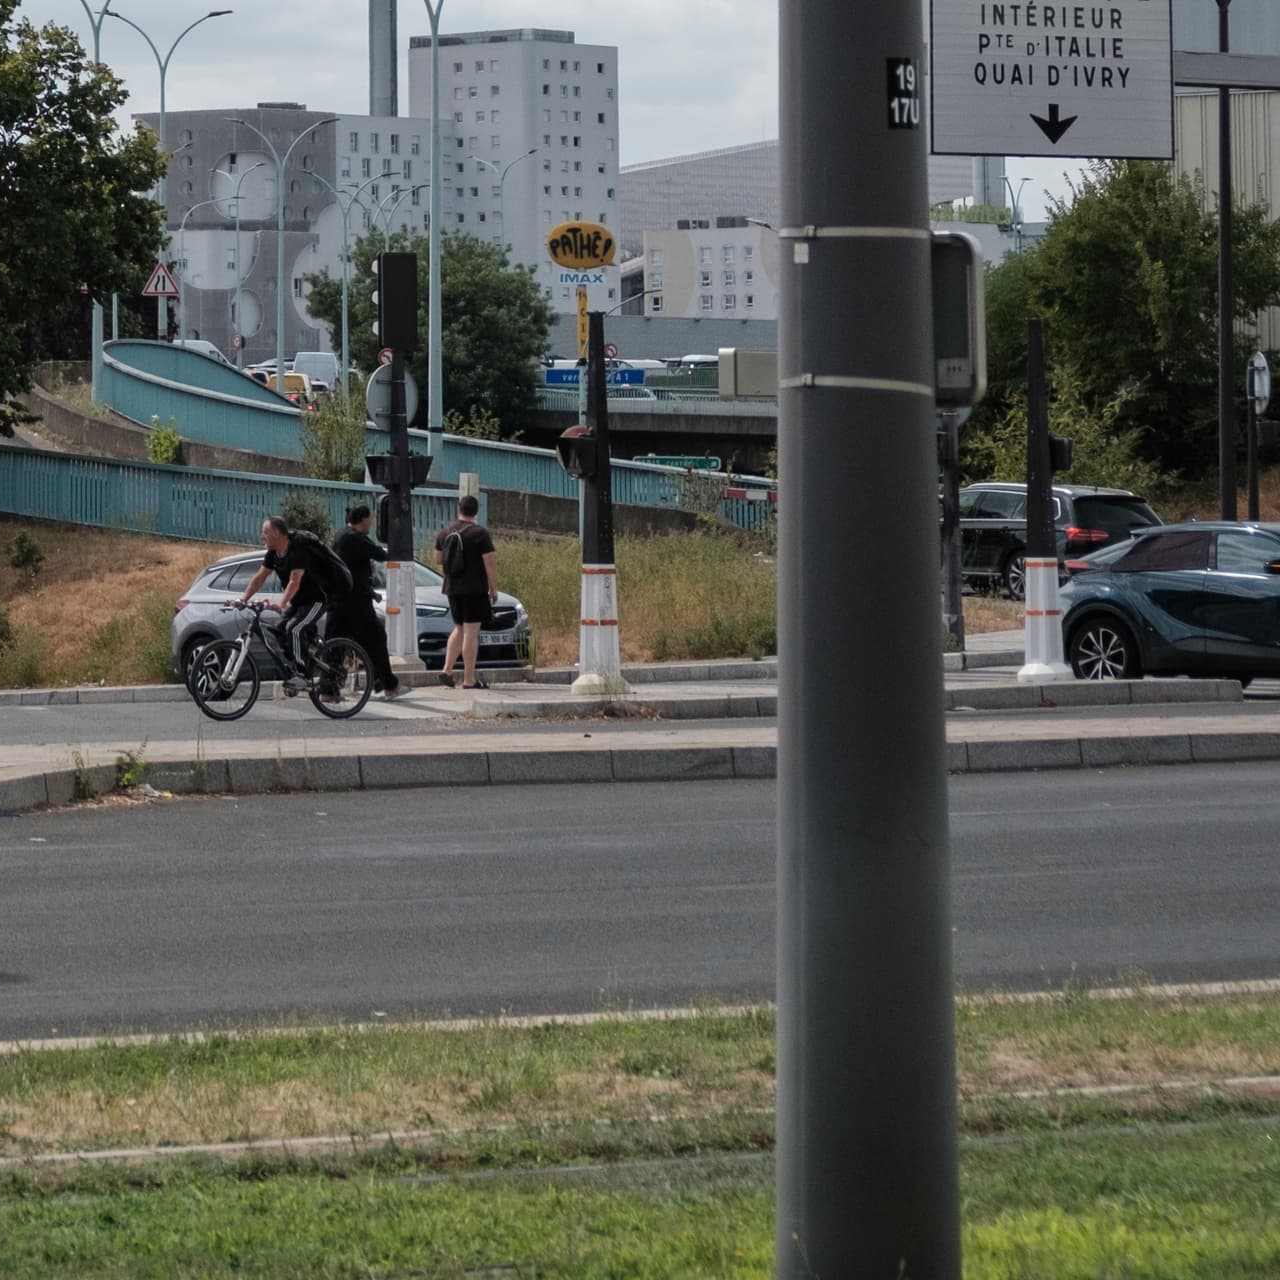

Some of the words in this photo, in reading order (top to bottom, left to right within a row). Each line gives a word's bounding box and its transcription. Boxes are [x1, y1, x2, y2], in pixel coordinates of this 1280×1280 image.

[981, 0, 1122, 29] INTÉRIEUR
[896, 64, 915, 91] 19
[974, 62, 1033, 86] QUAI
[1047, 64, 1130, 88] D'IVRY
[560, 273, 603, 284] IMAX
